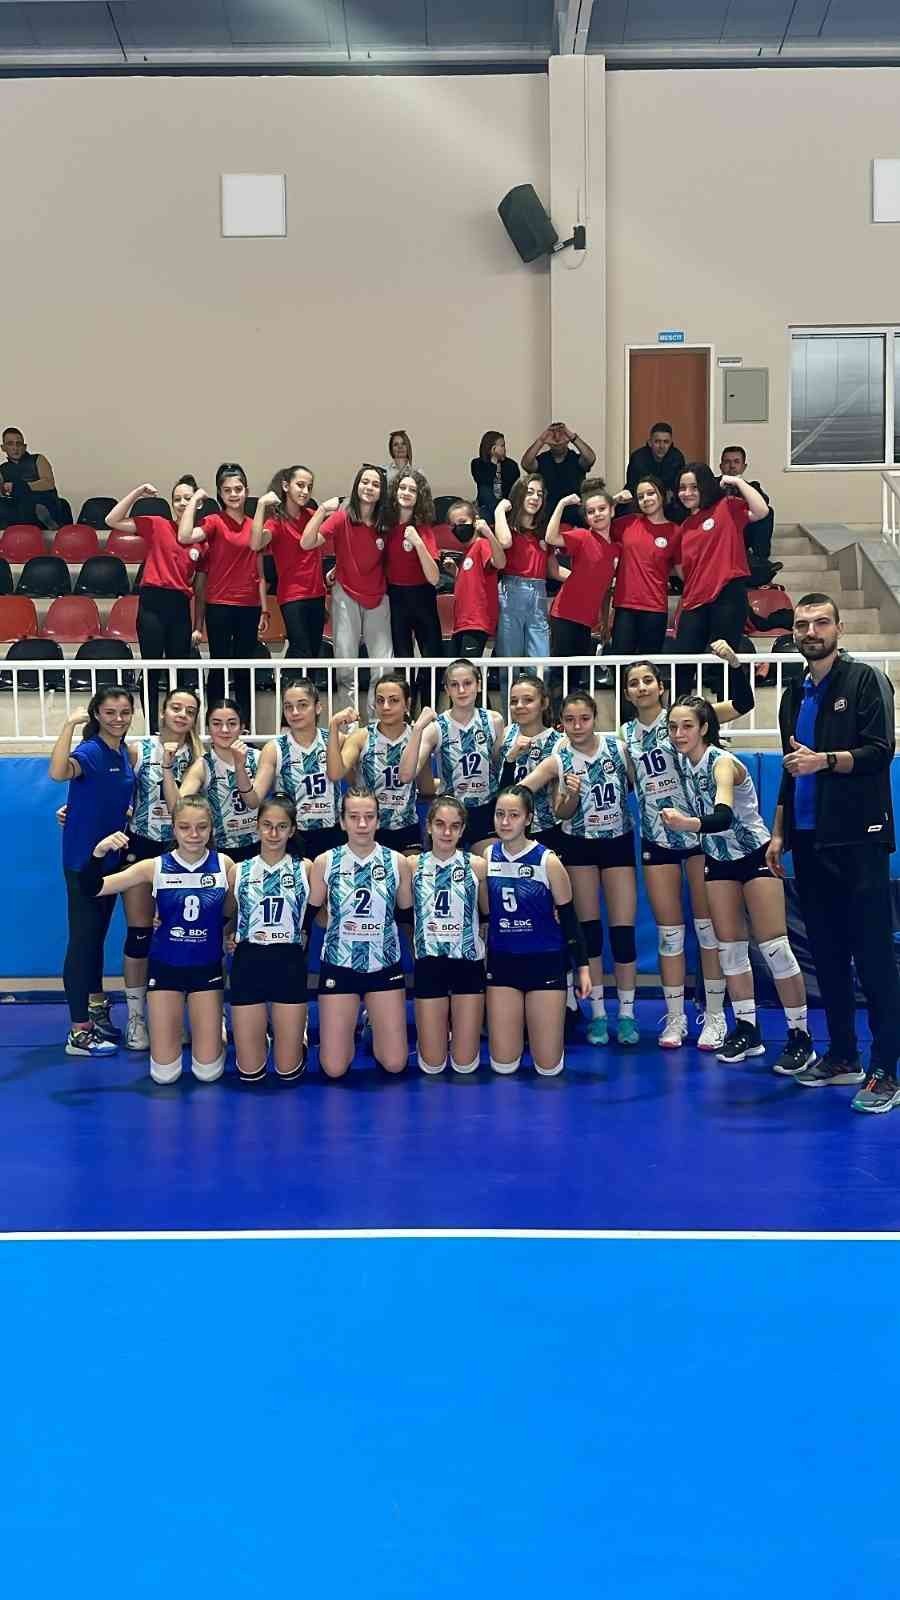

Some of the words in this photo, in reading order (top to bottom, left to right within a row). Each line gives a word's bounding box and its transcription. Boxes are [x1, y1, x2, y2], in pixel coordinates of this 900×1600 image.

[458, 752, 482, 777] 12
[640, 748, 667, 776] 16
[302, 773, 327, 796] 15
[658, 778, 676, 787] BDC
[590, 782, 617, 809] 14
[603, 812, 620, 821] BDC
[183, 895, 200, 922] 8
[259, 897, 285, 924] 17
[355, 888, 372, 915] 2
[434, 890, 450, 915] 4
[501, 887, 518, 913] 5
[188, 928, 208, 937] BDC
[271, 931, 290, 939] BDC
[441, 923, 460, 931] BDC
